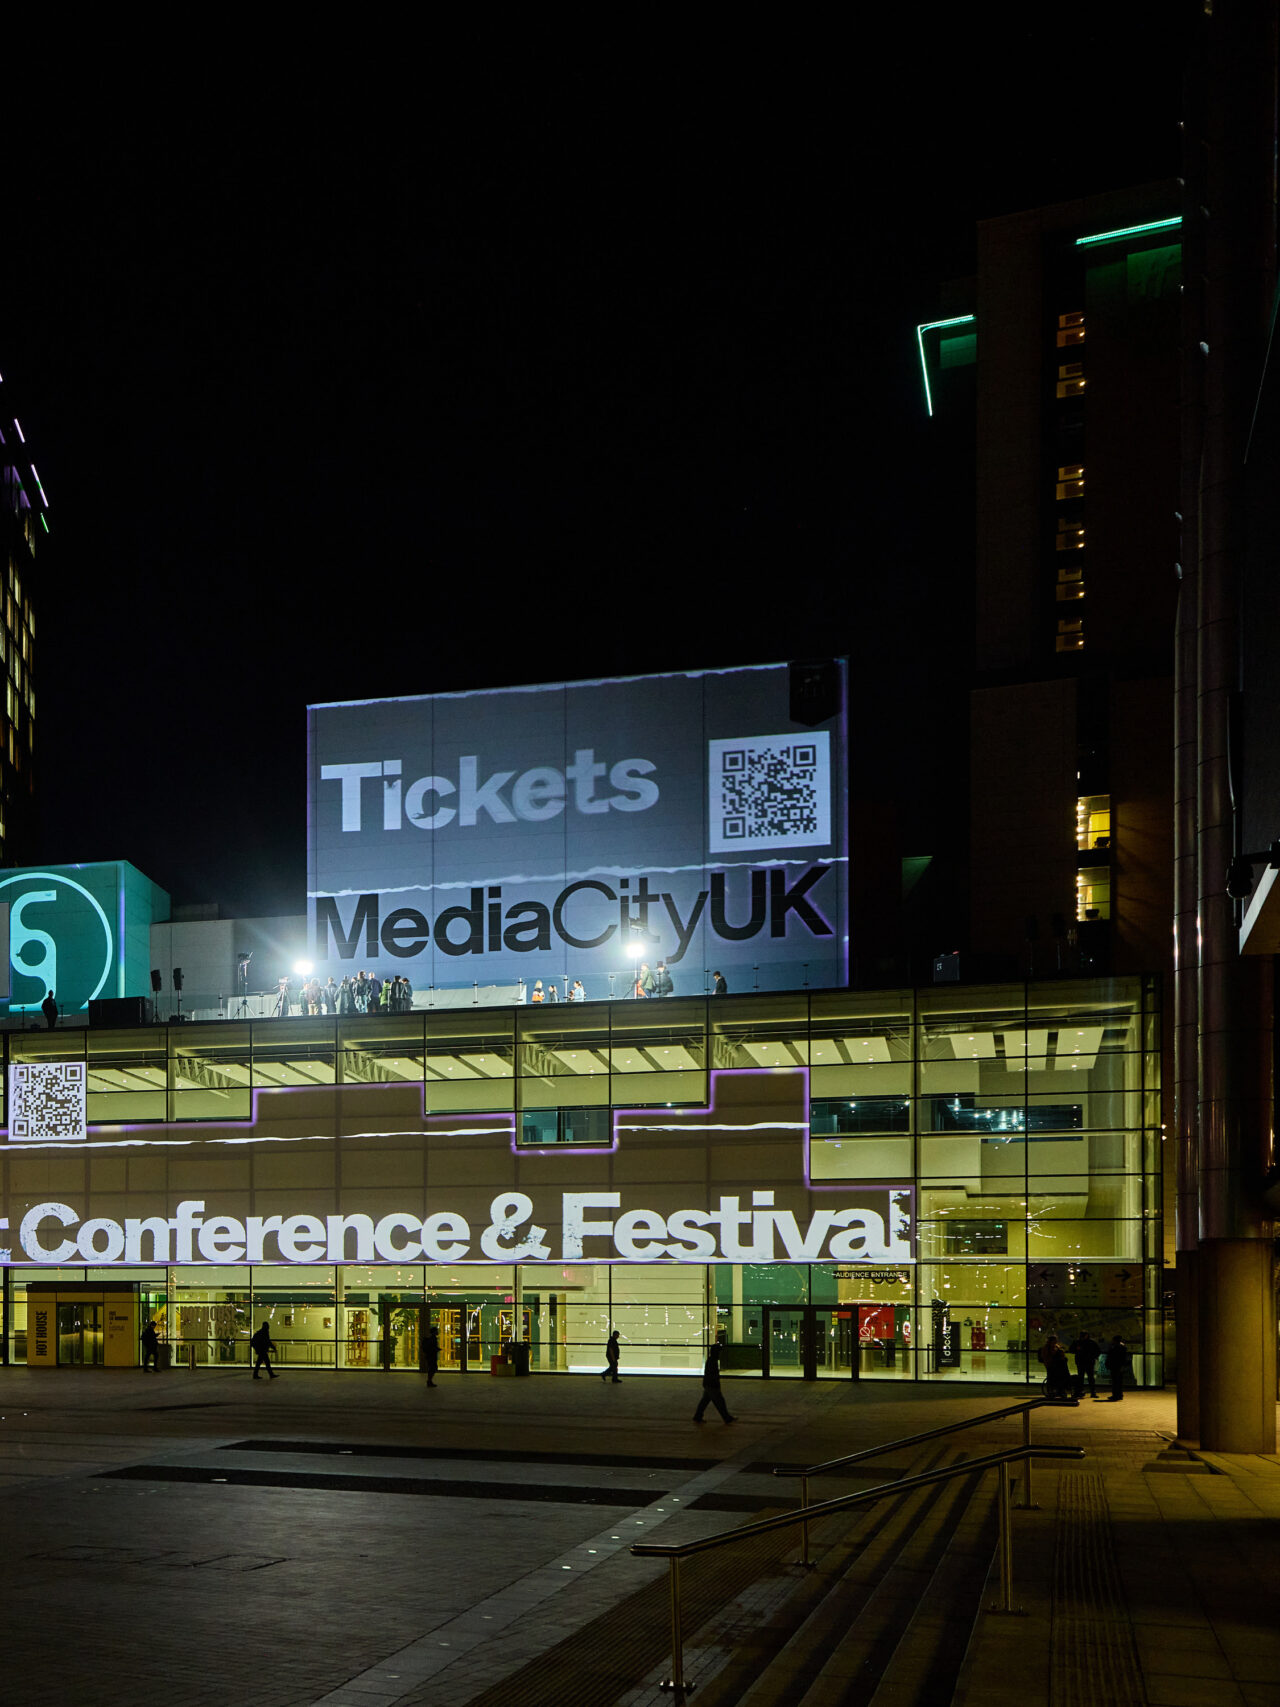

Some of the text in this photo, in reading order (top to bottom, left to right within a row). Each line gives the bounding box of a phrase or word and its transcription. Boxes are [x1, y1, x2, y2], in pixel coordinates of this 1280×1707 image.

[320, 748, 660, 832] Tickets
[316, 865, 834, 964] MediaCityUK
[19, 1200, 471, 1263] Conference
[480, 1191, 551, 1261] &
[561, 1190, 911, 1261] Festival
[35, 1311, 47, 1356] HOT HOUSE
